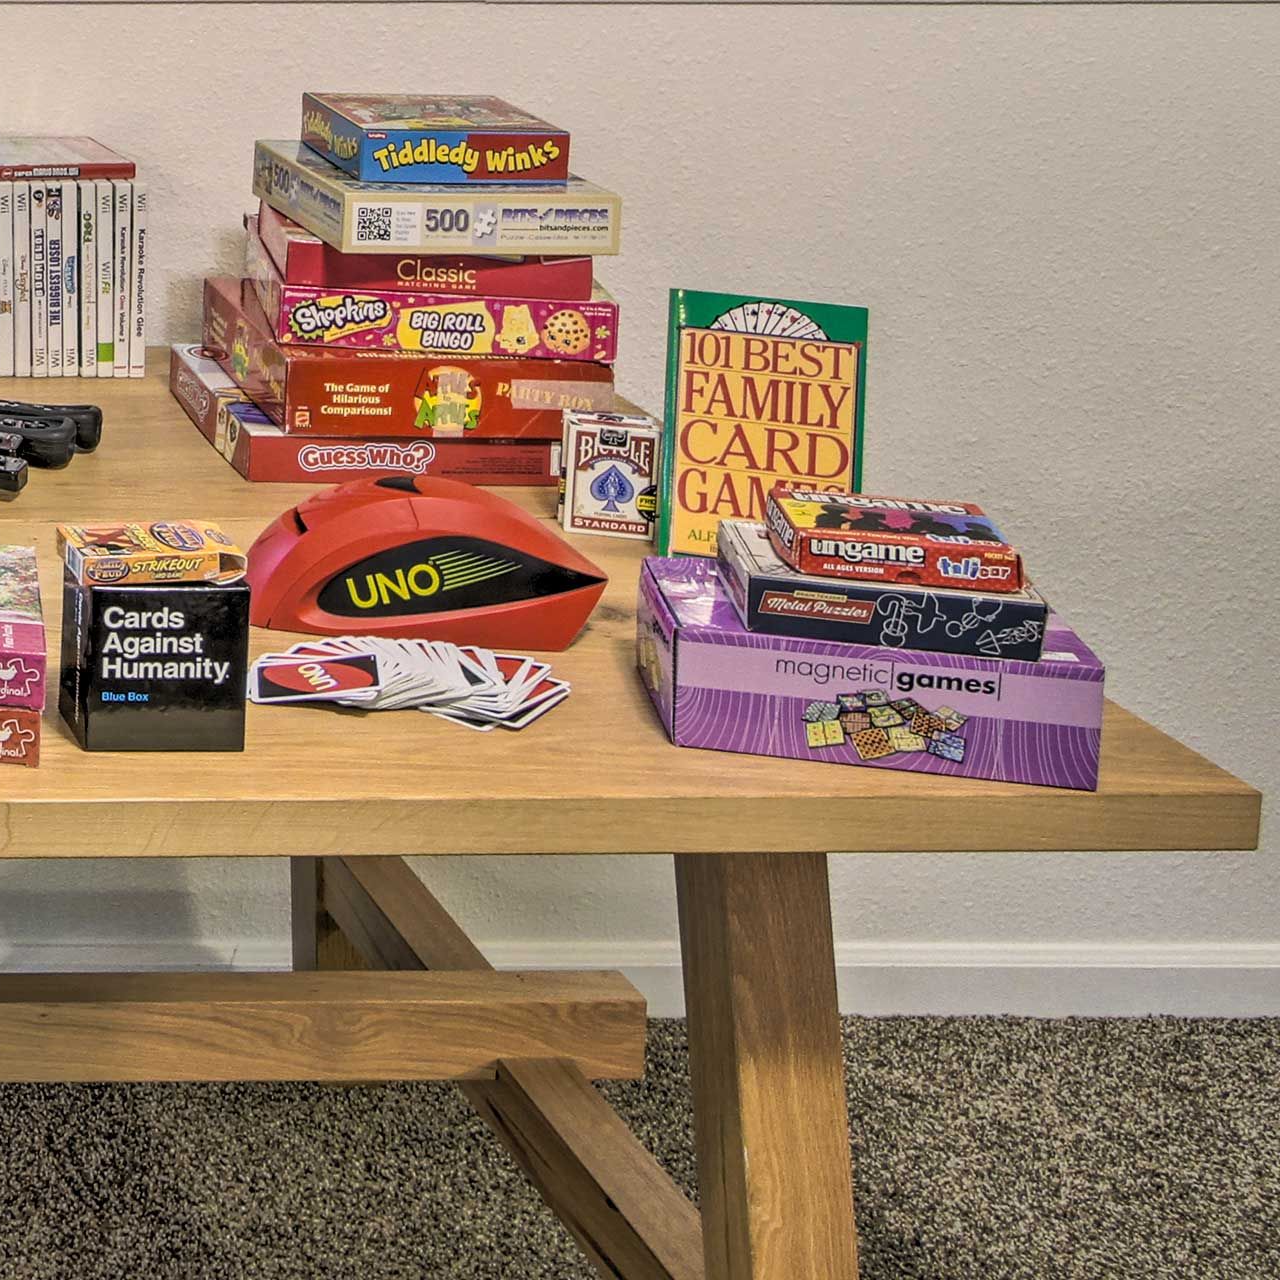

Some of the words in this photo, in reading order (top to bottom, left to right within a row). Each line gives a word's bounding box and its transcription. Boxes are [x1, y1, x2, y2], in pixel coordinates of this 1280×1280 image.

[374, 139, 479, 174] Tiddledy
[486, 139, 560, 173] Winks
[17, 193, 26, 212] Wii
[102, 194, 111, 214] Wii
[119, 193, 128, 212] Wii
[425, 208, 470, 232] 500
[539, 224, 609, 232] bitsandpieces.com
[49, 239, 61, 268] LOSER
[396, 259, 477, 284] Classic
[49, 271, 61, 312] BIGGEST
[49, 313, 61, 327] THE
[295, 296, 388, 334] Shopkins
[411, 311, 439, 331] BIG
[441, 312, 486, 333] ROLL
[421, 330, 474, 350] BINGO
[686, 332, 733, 369] 101
[743, 337, 853, 380] BEST
[324, 382, 345, 394] The
[347, 383, 376, 395] Game
[378, 383, 390, 394] of
[332, 394, 381, 406] Hilarious
[496, 382, 555, 404] PARTY
[682, 370, 851, 429] FAMILY
[321, 405, 393, 417] Comparisons!
[303, 444, 368, 471] Guess
[368, 443, 433, 472] Who?
[679, 419, 850, 478] CARD
[574, 518, 646, 532] STANDARD
[810, 540, 925, 564] ungame
[133, 558, 203, 574] STRIKEOUT
[855, 567, 885, 575] VERSION
[346, 563, 439, 608] UNO
[102, 606, 184, 630] Cards
[767, 597, 812, 612] Metal
[813, 600, 869, 618] Puzzles
[102, 632, 202, 658] Against
[297, 662, 340, 692] UNO
[775, 655, 888, 687] magnetic
[896, 669, 996, 697] games
[101, 691, 126, 702] Blue
[129, 691, 149, 702] Box
